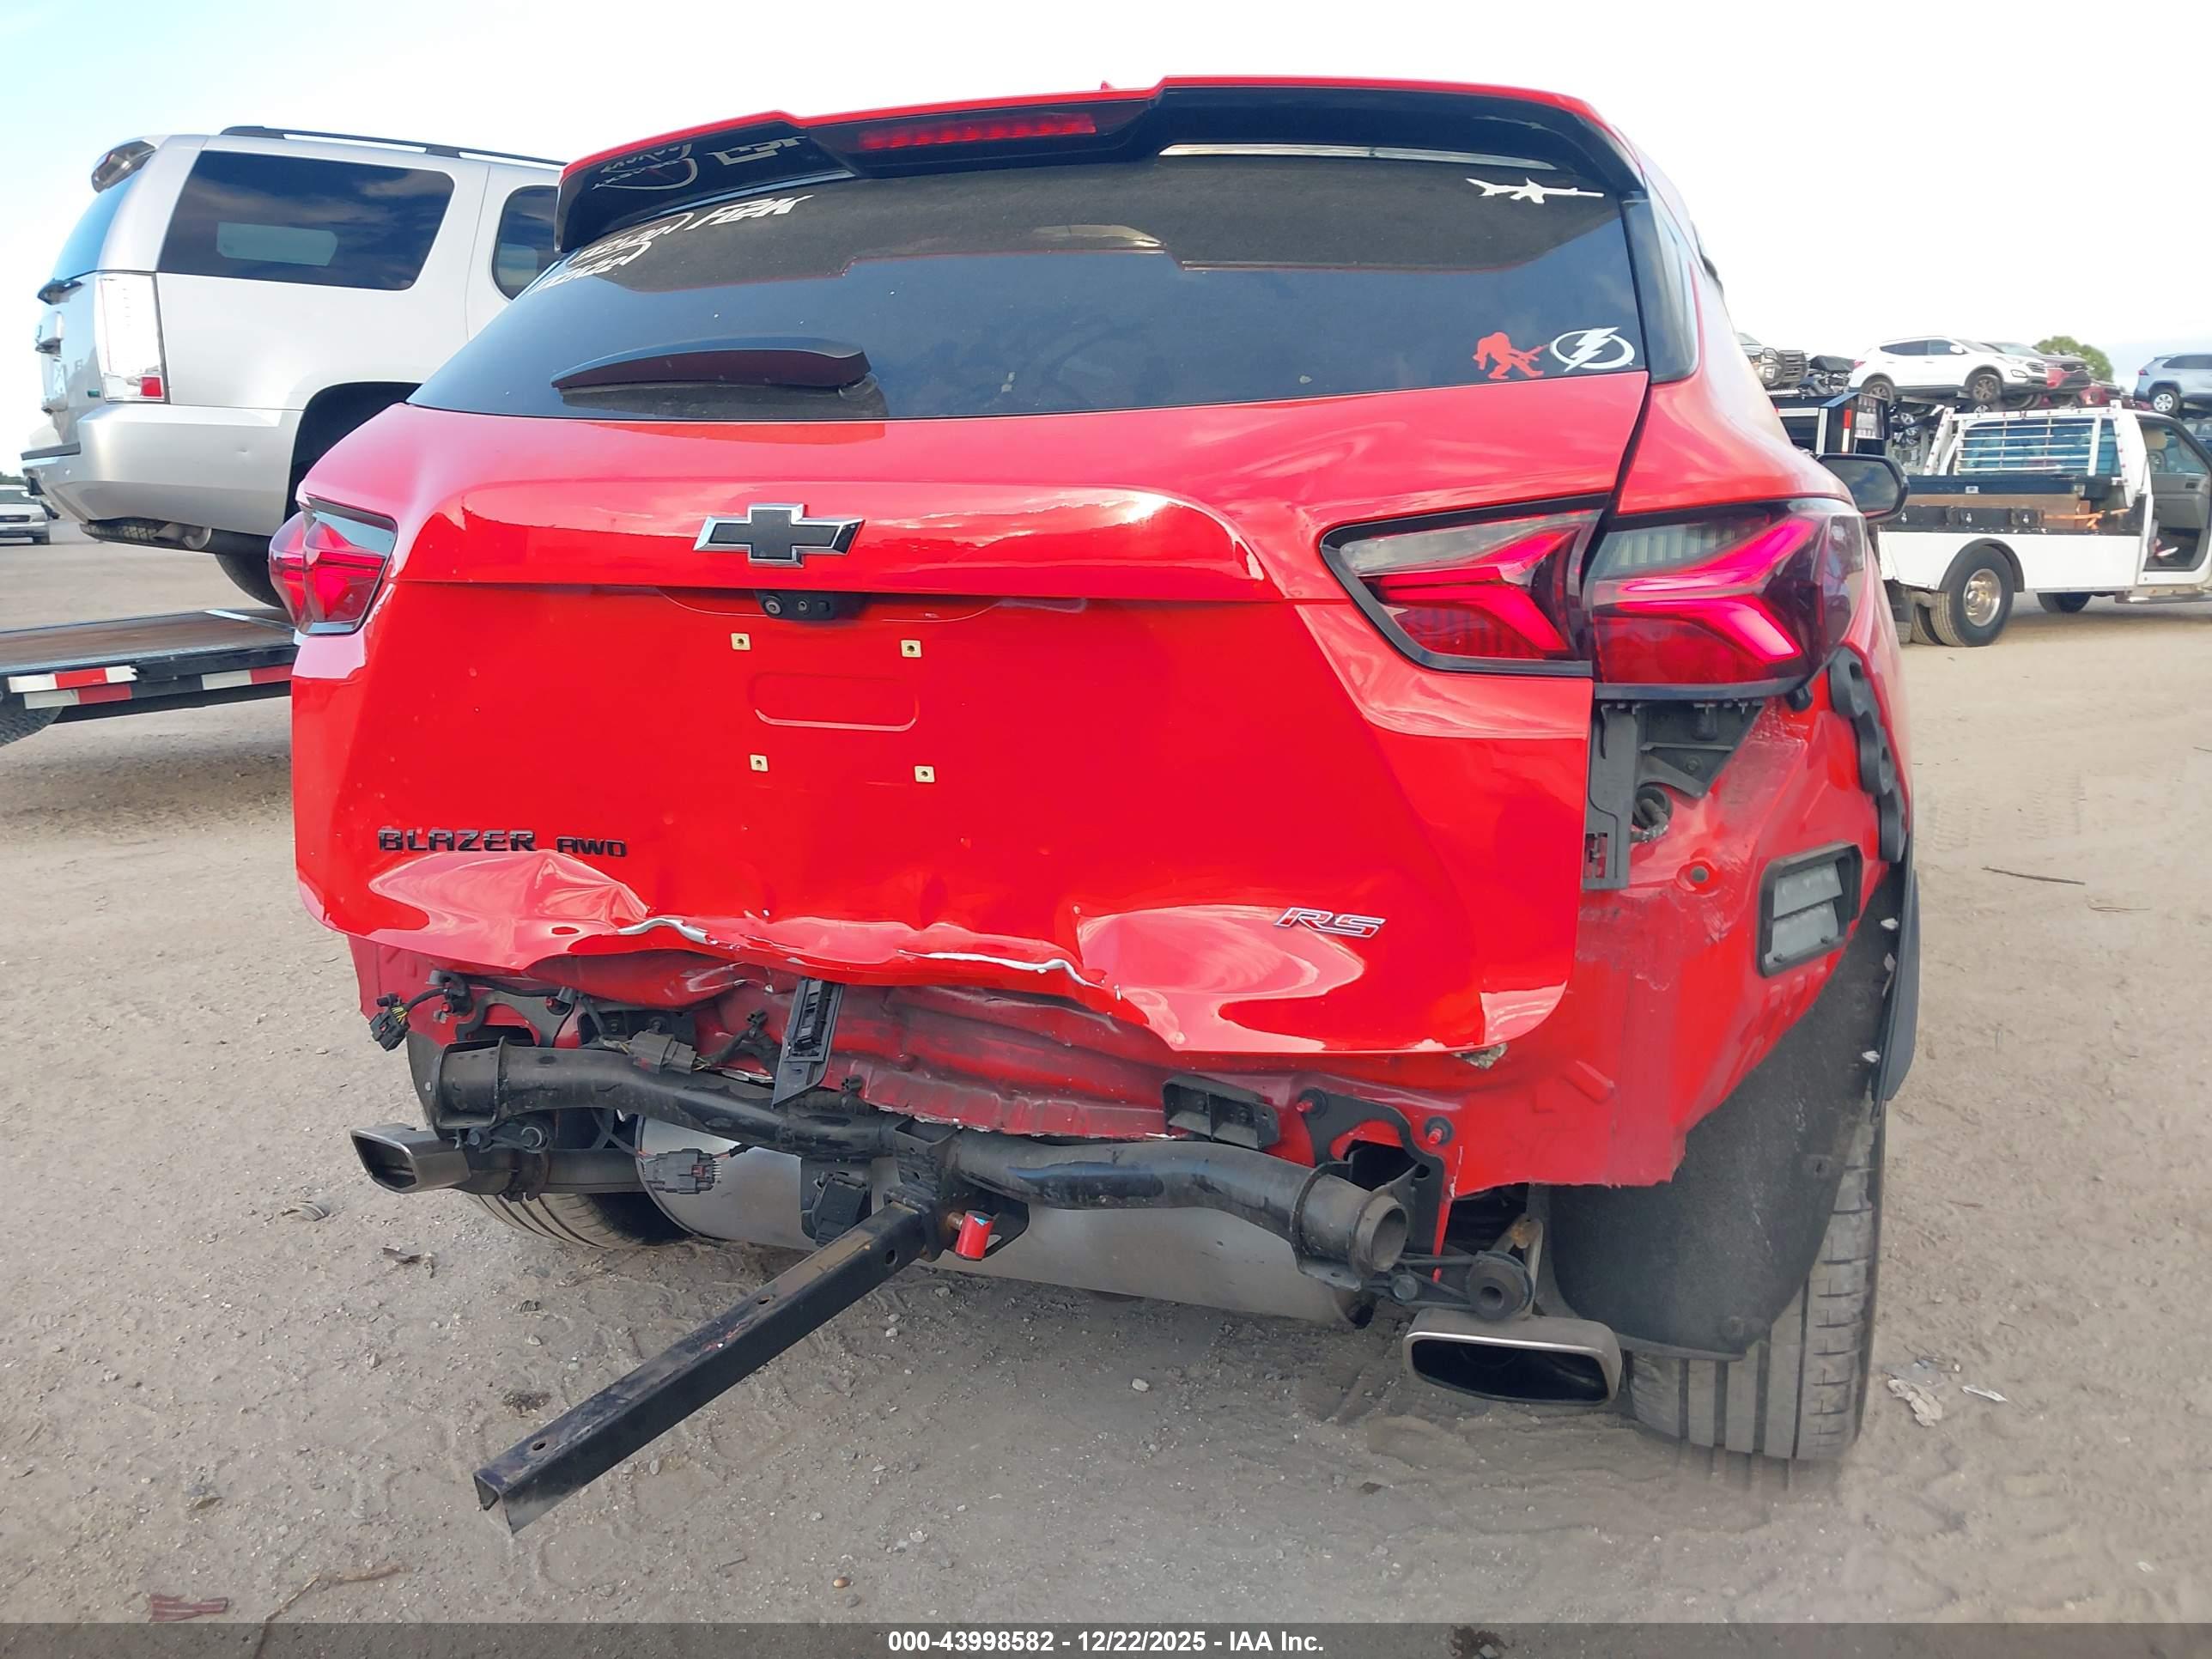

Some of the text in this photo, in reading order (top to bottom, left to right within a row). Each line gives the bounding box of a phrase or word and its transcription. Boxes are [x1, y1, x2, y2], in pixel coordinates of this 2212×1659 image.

[378, 828, 627, 857] BLAZER AWD
[1273, 907, 1387, 938] RS
